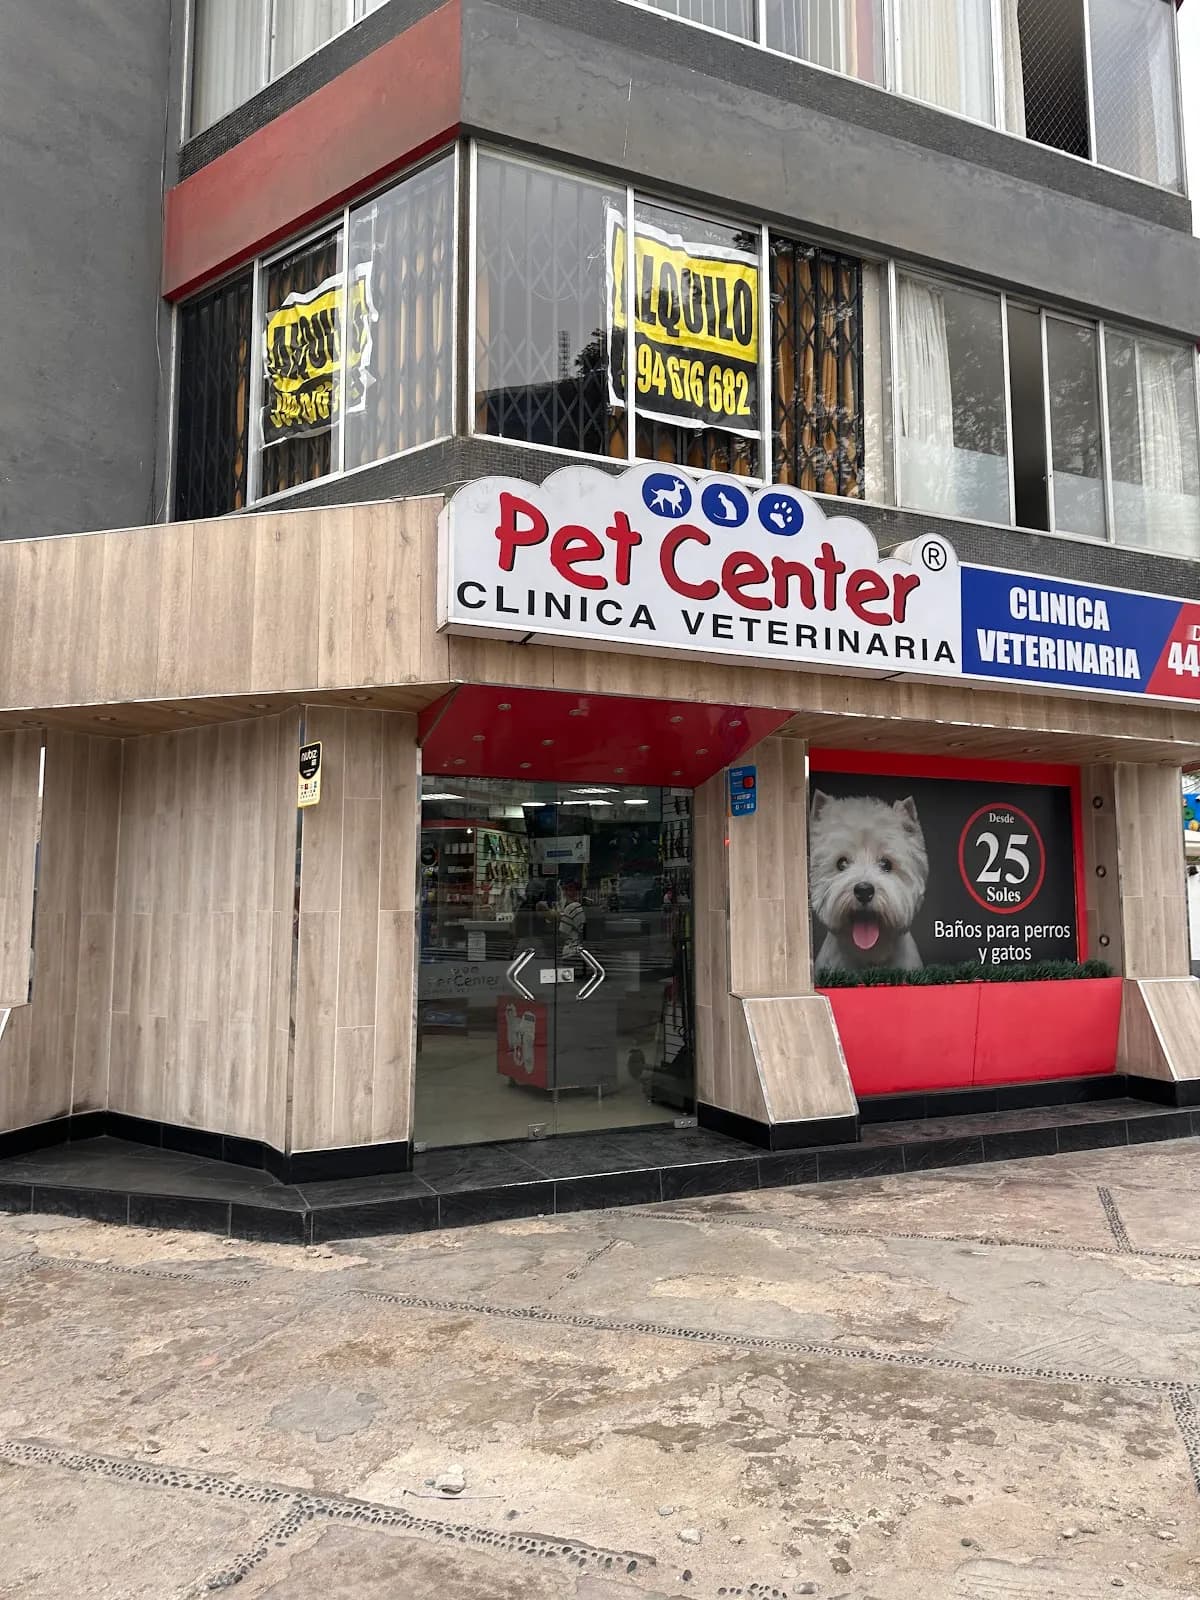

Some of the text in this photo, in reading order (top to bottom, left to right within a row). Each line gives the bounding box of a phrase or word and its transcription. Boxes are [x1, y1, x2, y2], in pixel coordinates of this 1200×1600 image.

[621, 343, 667, 396] 94
[708, 365, 751, 416] 682
[495, 491, 642, 590] Pet
[660, 524, 920, 626] Center
[456, 581, 956, 664] CLINICA VETERINARIA
[1009, 586, 1111, 632] CLINICA
[976, 628, 1141, 680] VETERINARIA
[988, 812, 1015, 824] Desde
[975, 831, 1030, 884] 25
[986, 886, 1021, 902] Soles
[934, 920, 1071, 942] Baños para perros
[978, 945, 1032, 964] y gatos
